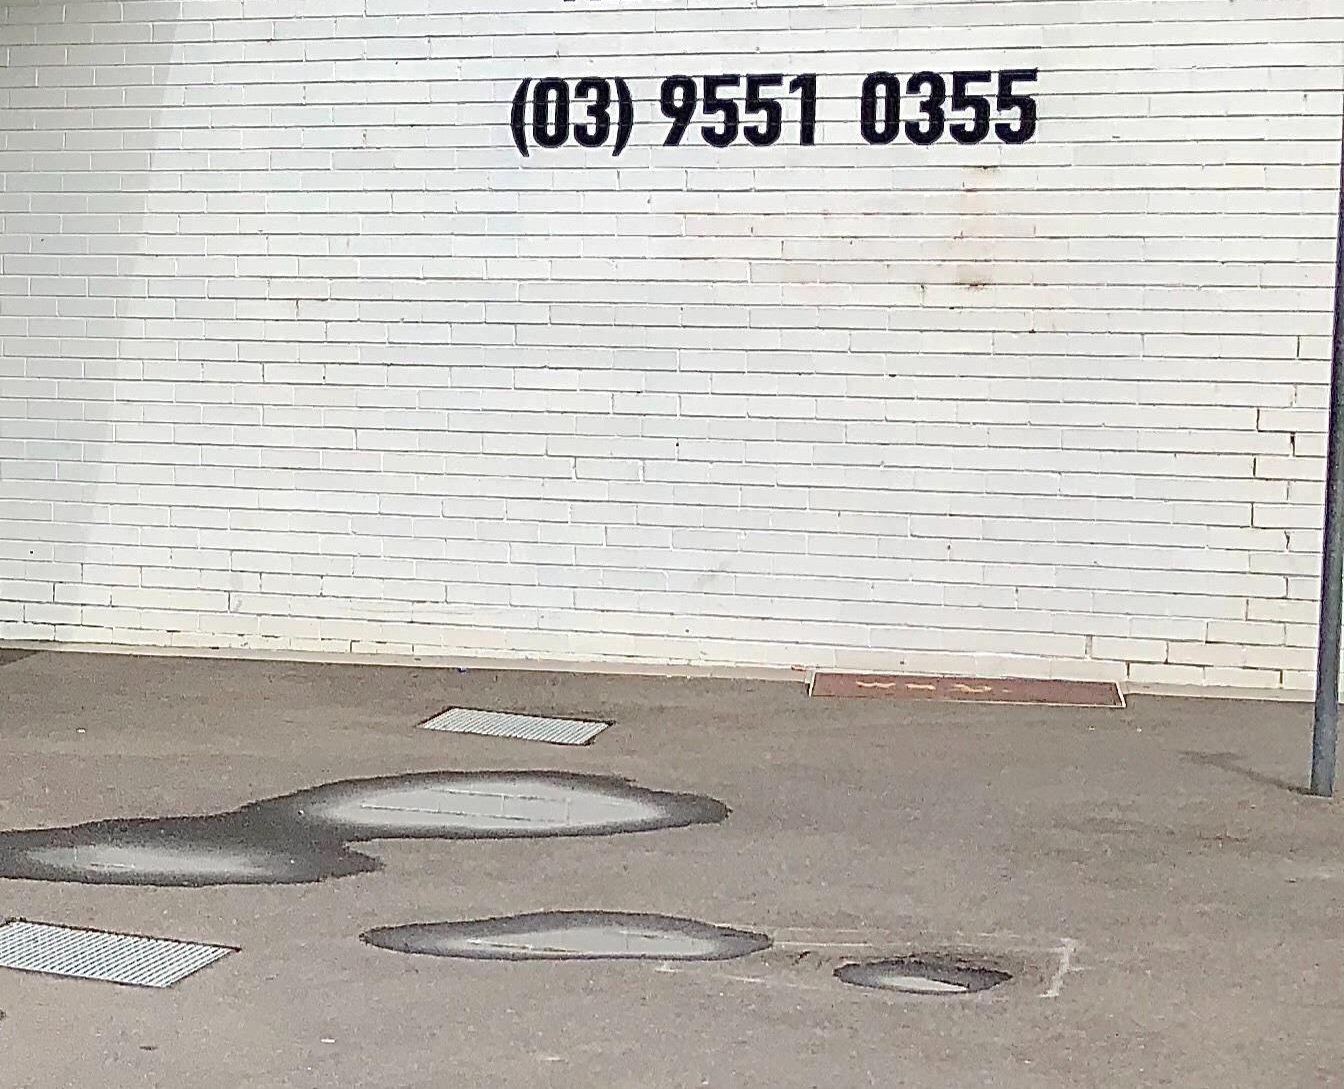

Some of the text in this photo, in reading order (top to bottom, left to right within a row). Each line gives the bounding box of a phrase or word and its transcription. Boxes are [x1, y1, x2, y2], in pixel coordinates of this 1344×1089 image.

[510, 68, 1041, 157] (03) 9551 0355
